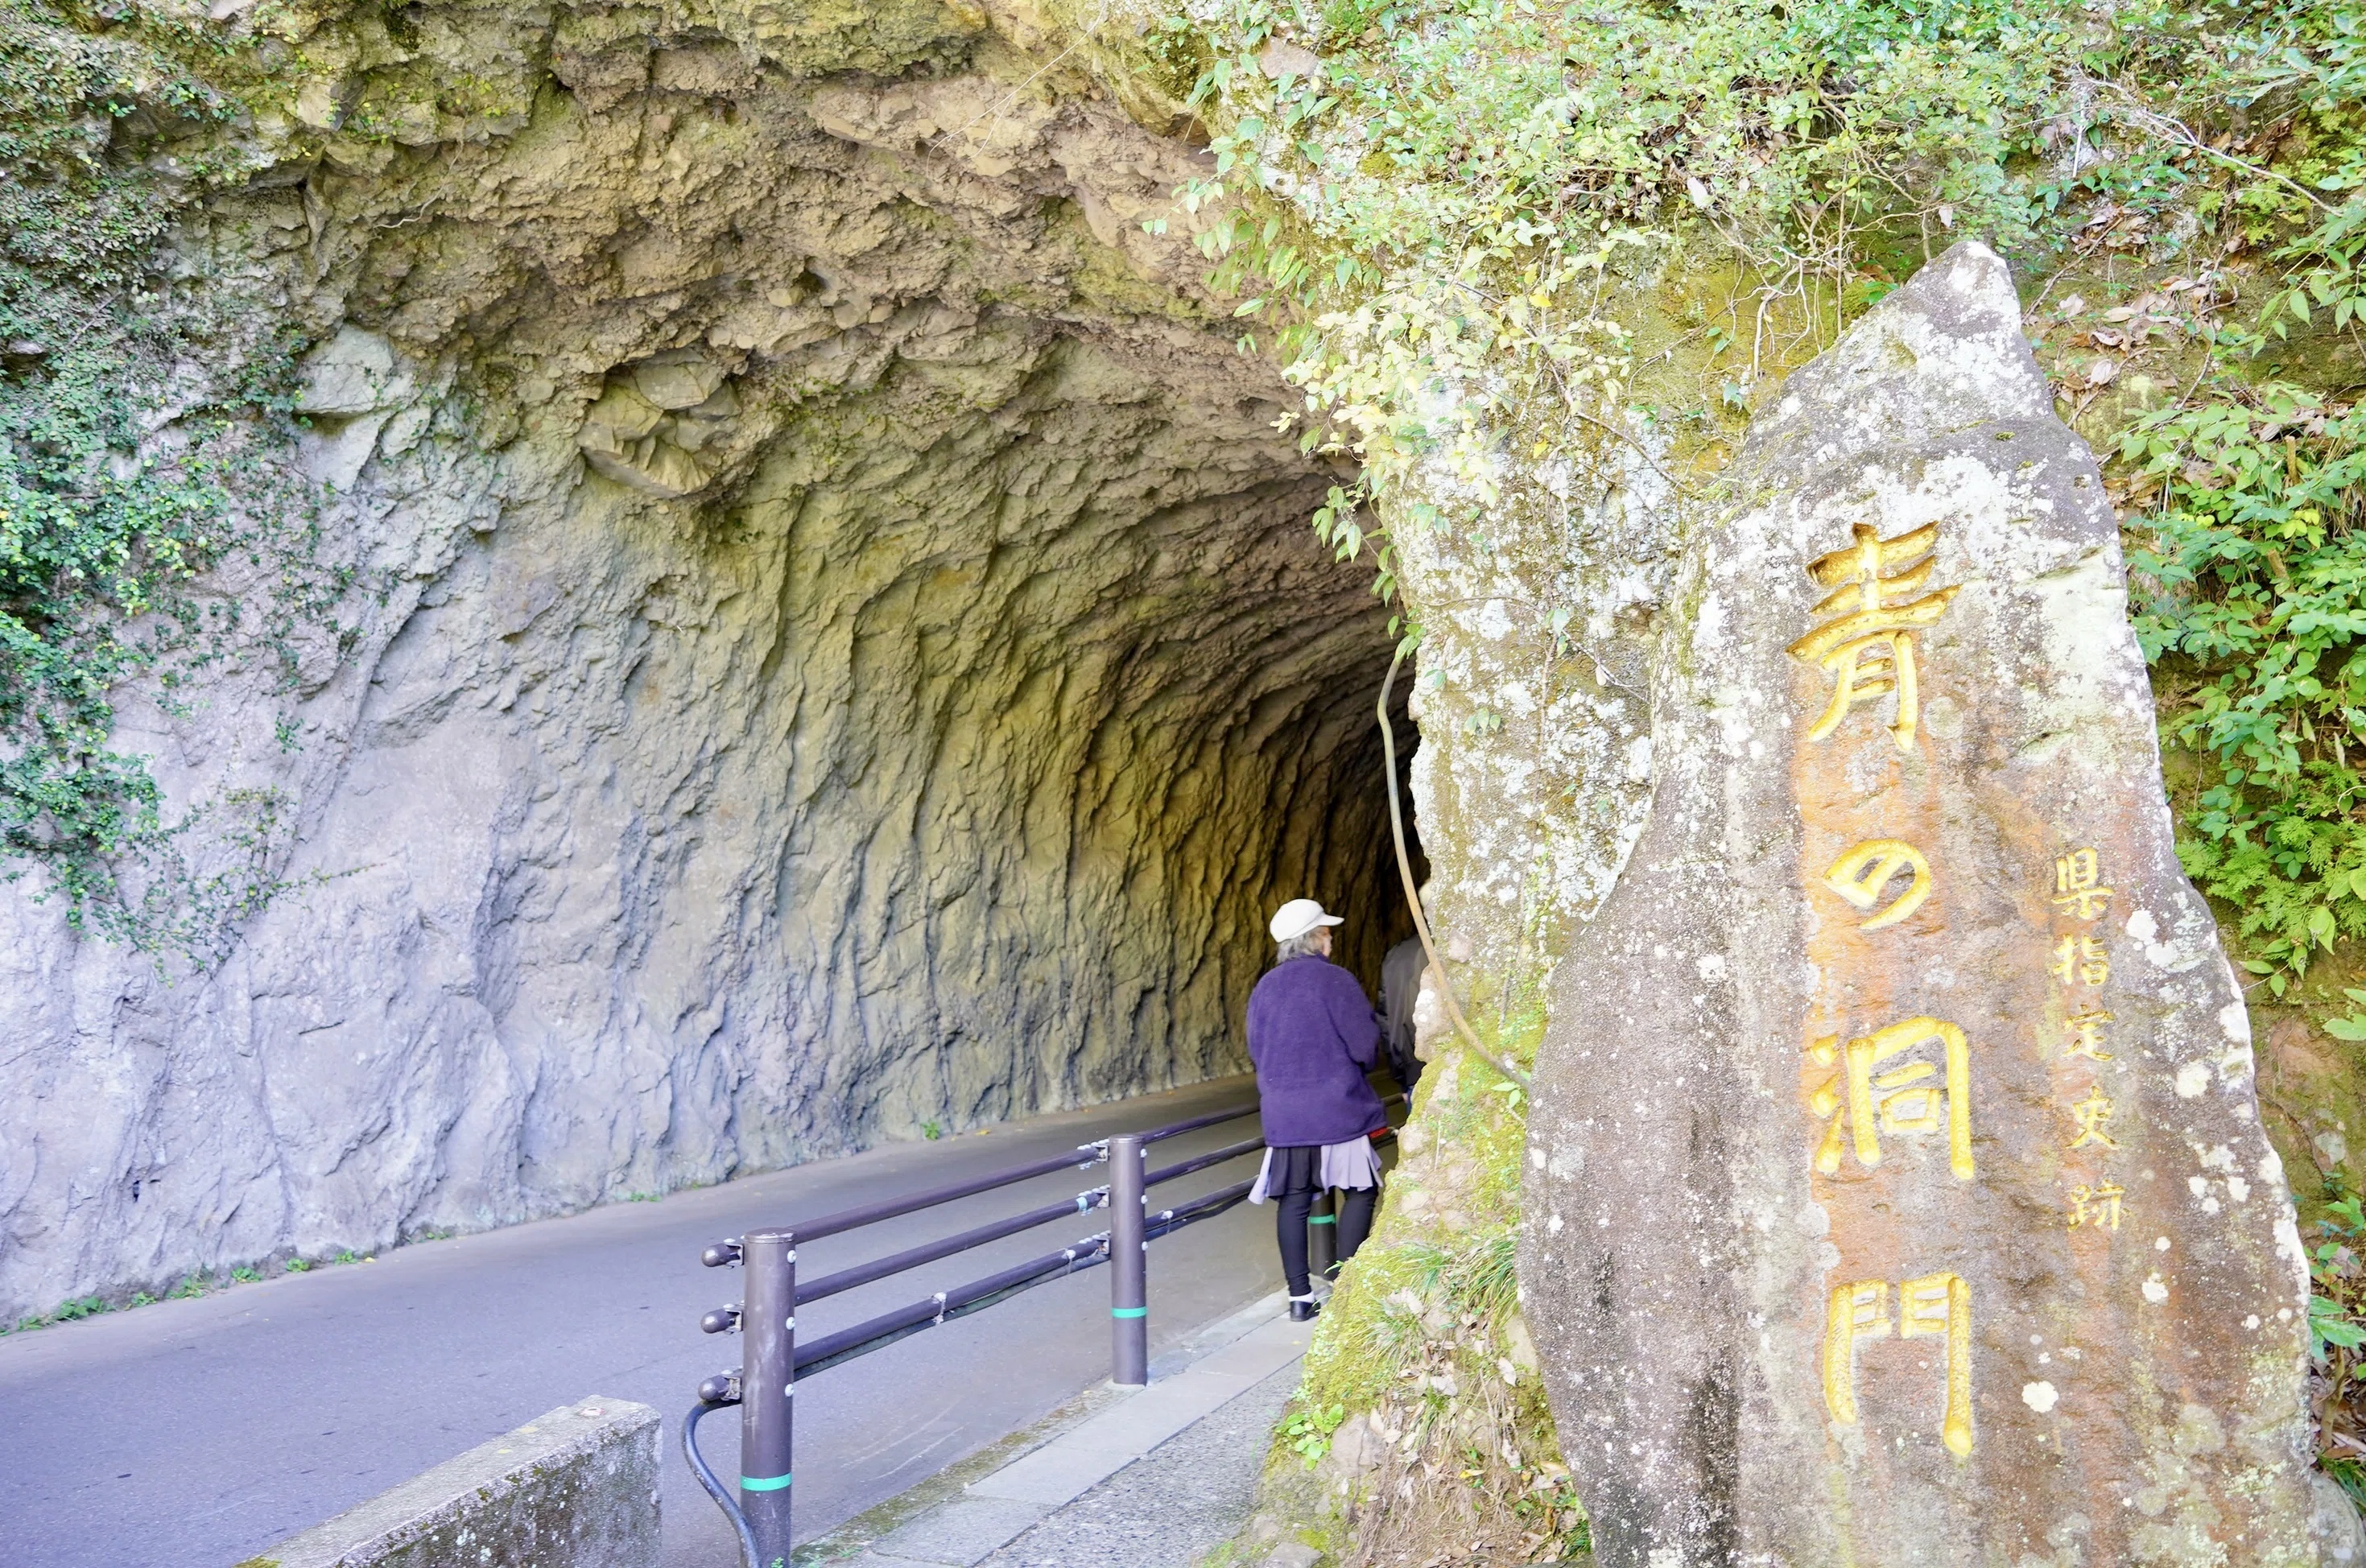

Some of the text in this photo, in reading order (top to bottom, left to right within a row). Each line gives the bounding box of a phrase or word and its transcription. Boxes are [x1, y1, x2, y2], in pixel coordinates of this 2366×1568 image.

[1785, 521, 1975, 1456] 青の洞門
[2050, 847, 2130, 1232] 県指定史跡
